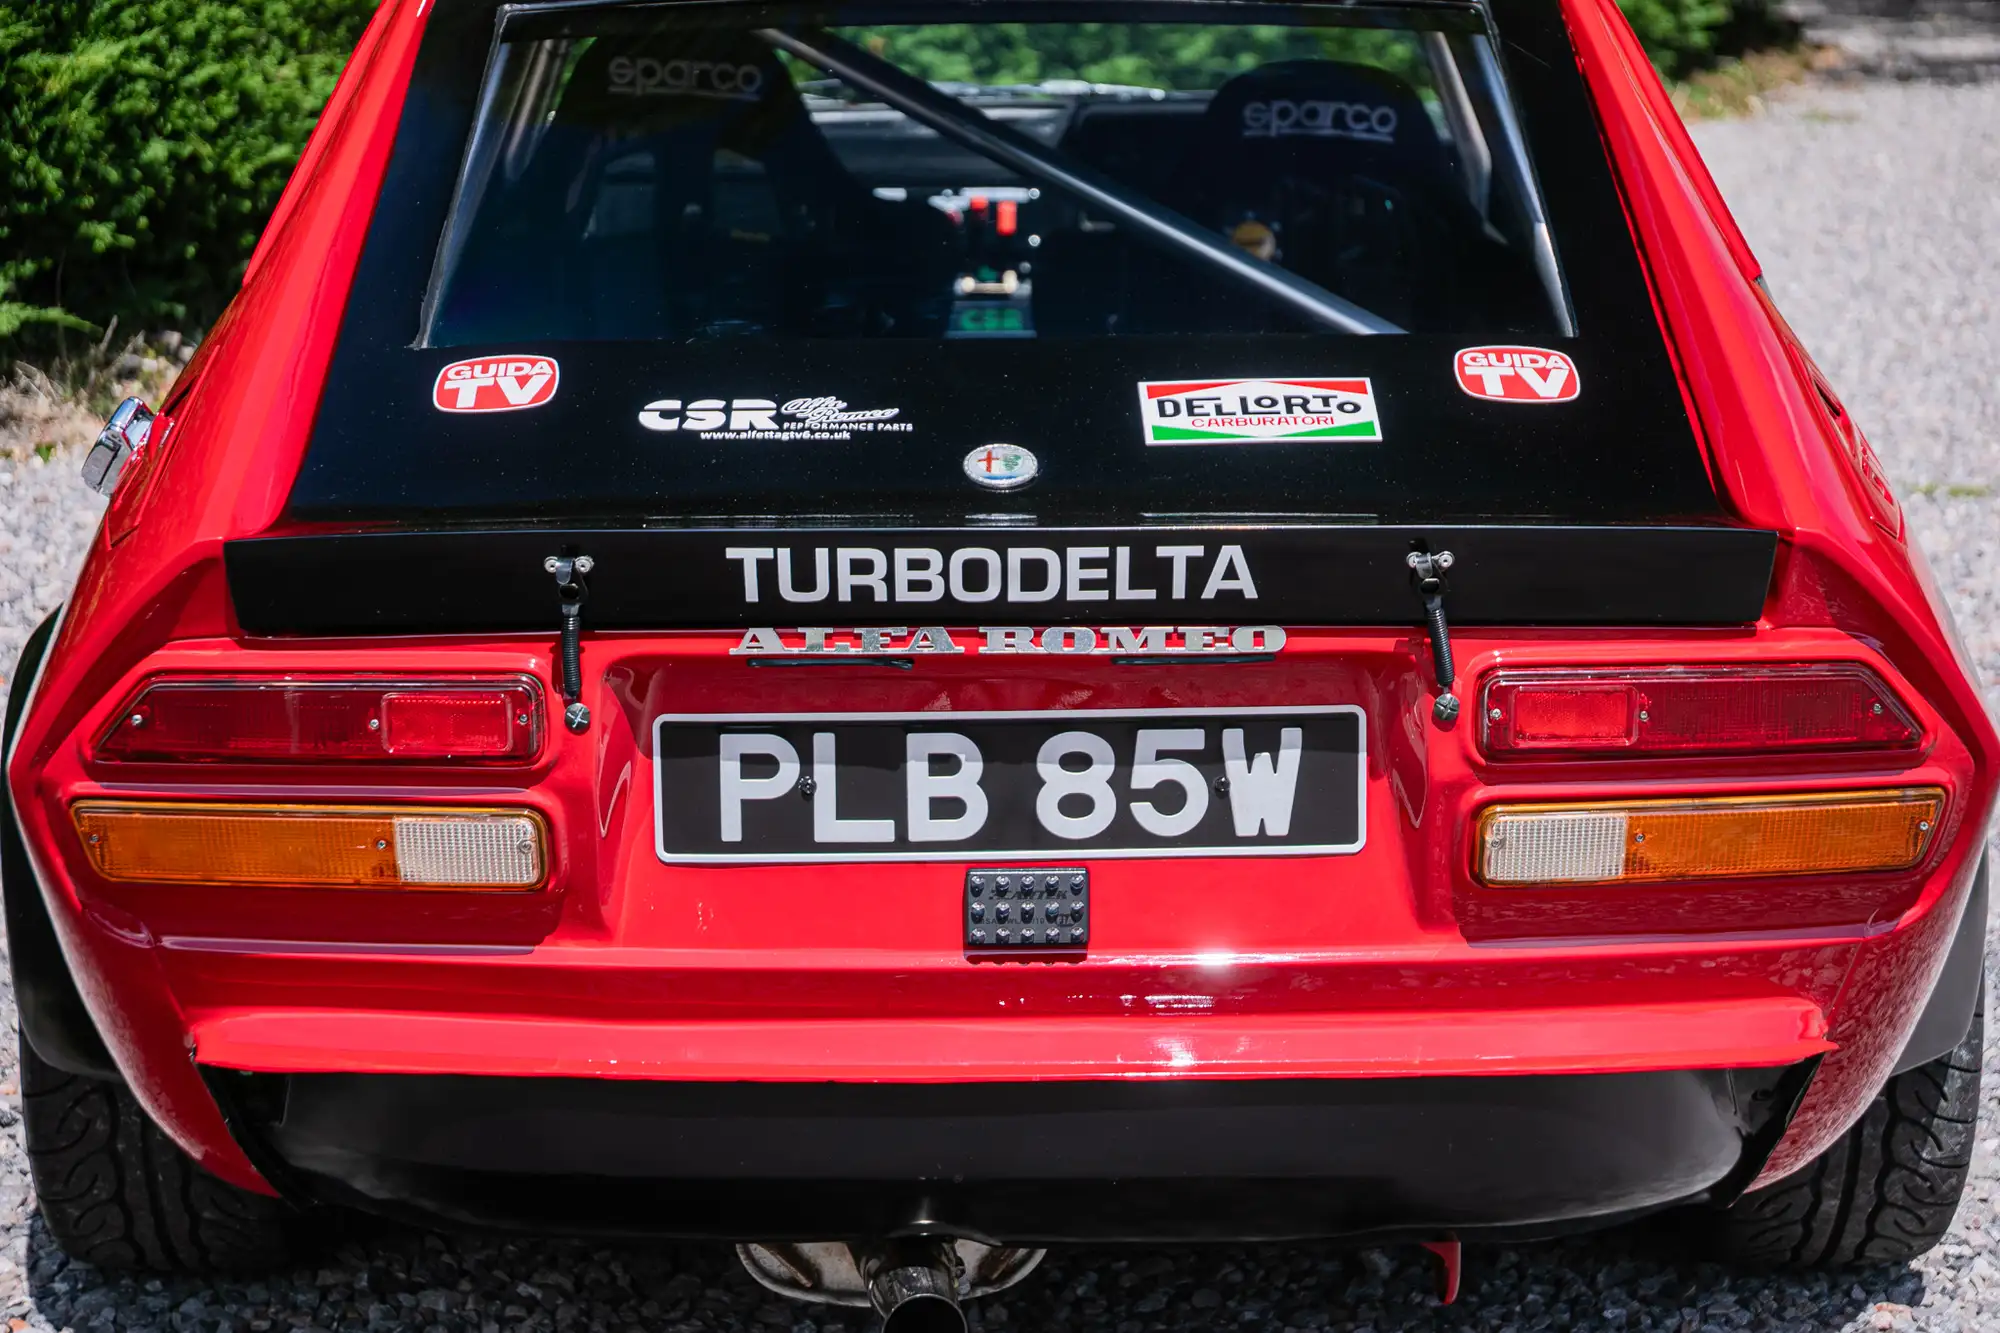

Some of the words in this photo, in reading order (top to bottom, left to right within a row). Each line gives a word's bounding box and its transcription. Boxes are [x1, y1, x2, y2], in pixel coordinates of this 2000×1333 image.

[608, 56, 763, 100] sparco
[1243, 100, 1397, 142] sparco
[447, 361, 554, 380] GUIDA
[1462, 352, 1570, 369] GUIDA
[443, 374, 552, 409] TV
[1464, 366, 1571, 398] TV
[638, 399, 779, 431] CSR
[877, 423, 913, 432] PARTS
[1191, 416, 1335, 428] CARBURATORI
[700, 430, 850, 440] www.alfettagtv6.co.uk
[725, 545, 1259, 603] TURBODELTA
[729, 626, 965, 655] ALFA
[978, 624, 1287, 653] ROMEO
[719, 732, 989, 843] PLB
[1036, 727, 1303, 839] 85W
